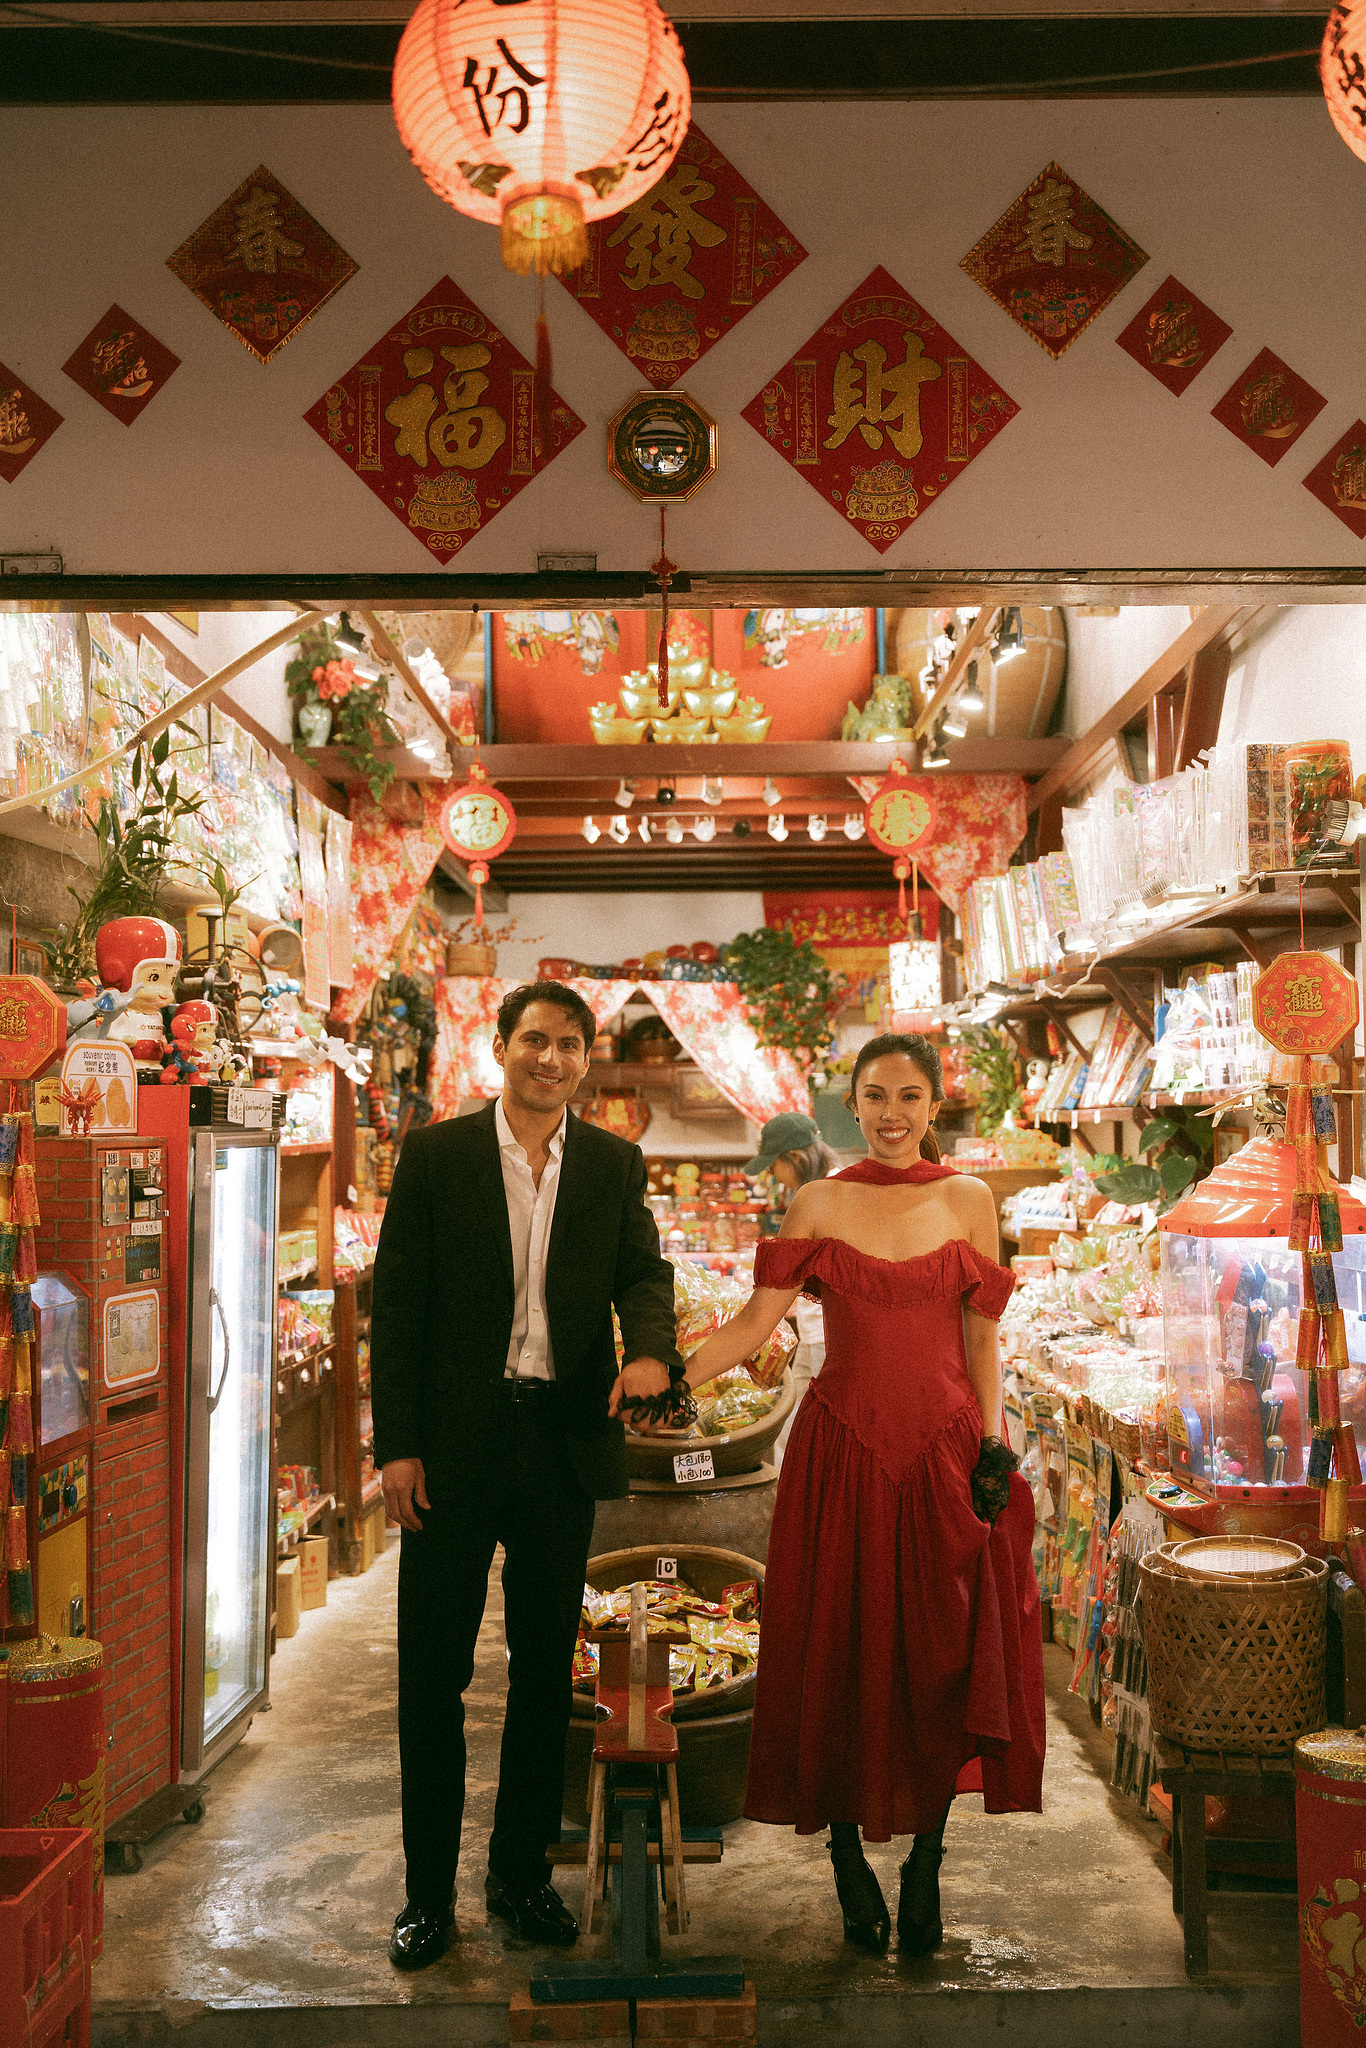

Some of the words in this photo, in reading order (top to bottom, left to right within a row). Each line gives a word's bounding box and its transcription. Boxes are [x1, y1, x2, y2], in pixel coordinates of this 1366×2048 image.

[453, 0, 546, 138] 份
[223, 185, 307, 277] 春
[605, 163, 729, 300] 發
[1012, 177, 1097, 269] 春
[384, 341, 507, 471] 福
[822, 329, 944, 460] 財
[83, 1051, 103, 1060] souvenir
[104, 1051, 117, 1060] coins
